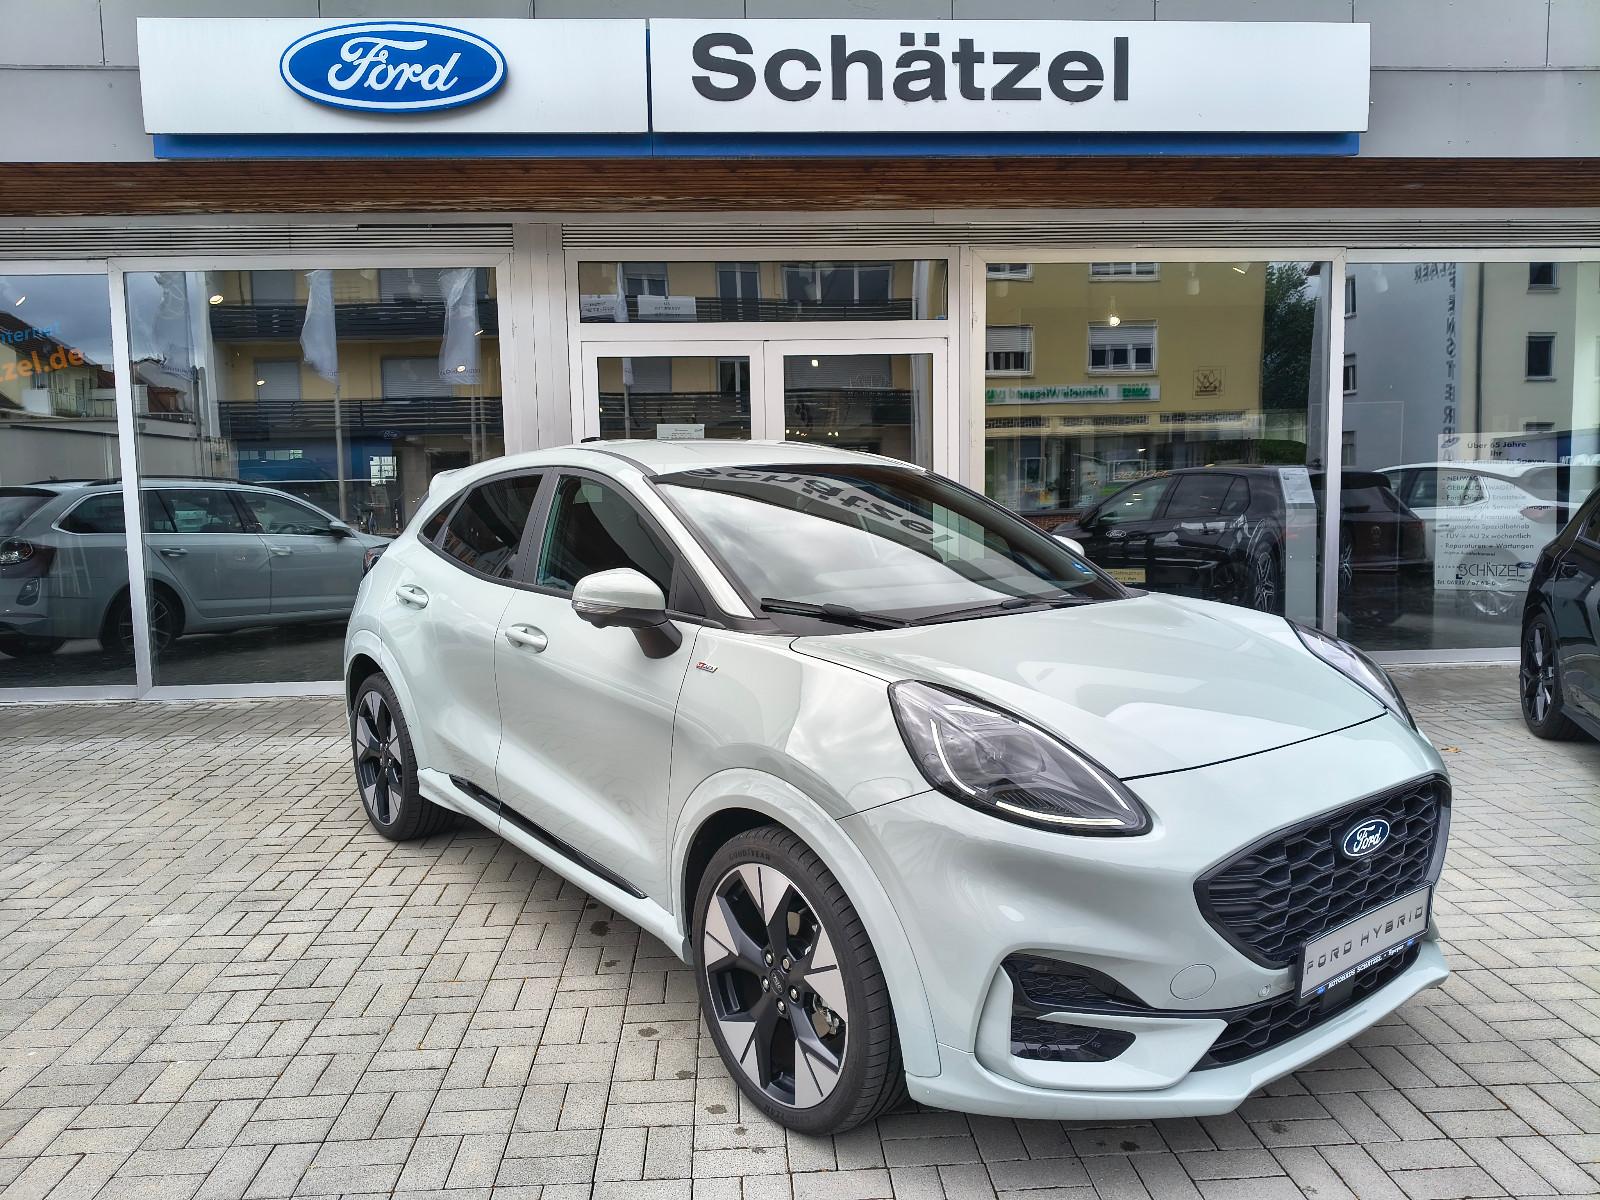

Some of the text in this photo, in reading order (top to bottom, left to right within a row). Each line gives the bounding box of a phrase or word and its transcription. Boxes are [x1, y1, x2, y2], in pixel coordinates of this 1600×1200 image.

[327, 36, 462, 93] Ford
[691, 31, 1129, 102] Schätzel
[0, 345, 84, 382] zel.de
[1503, 440, 1528, 448] Jahre
[1306, 906, 1423, 975] FORD HYBRID
